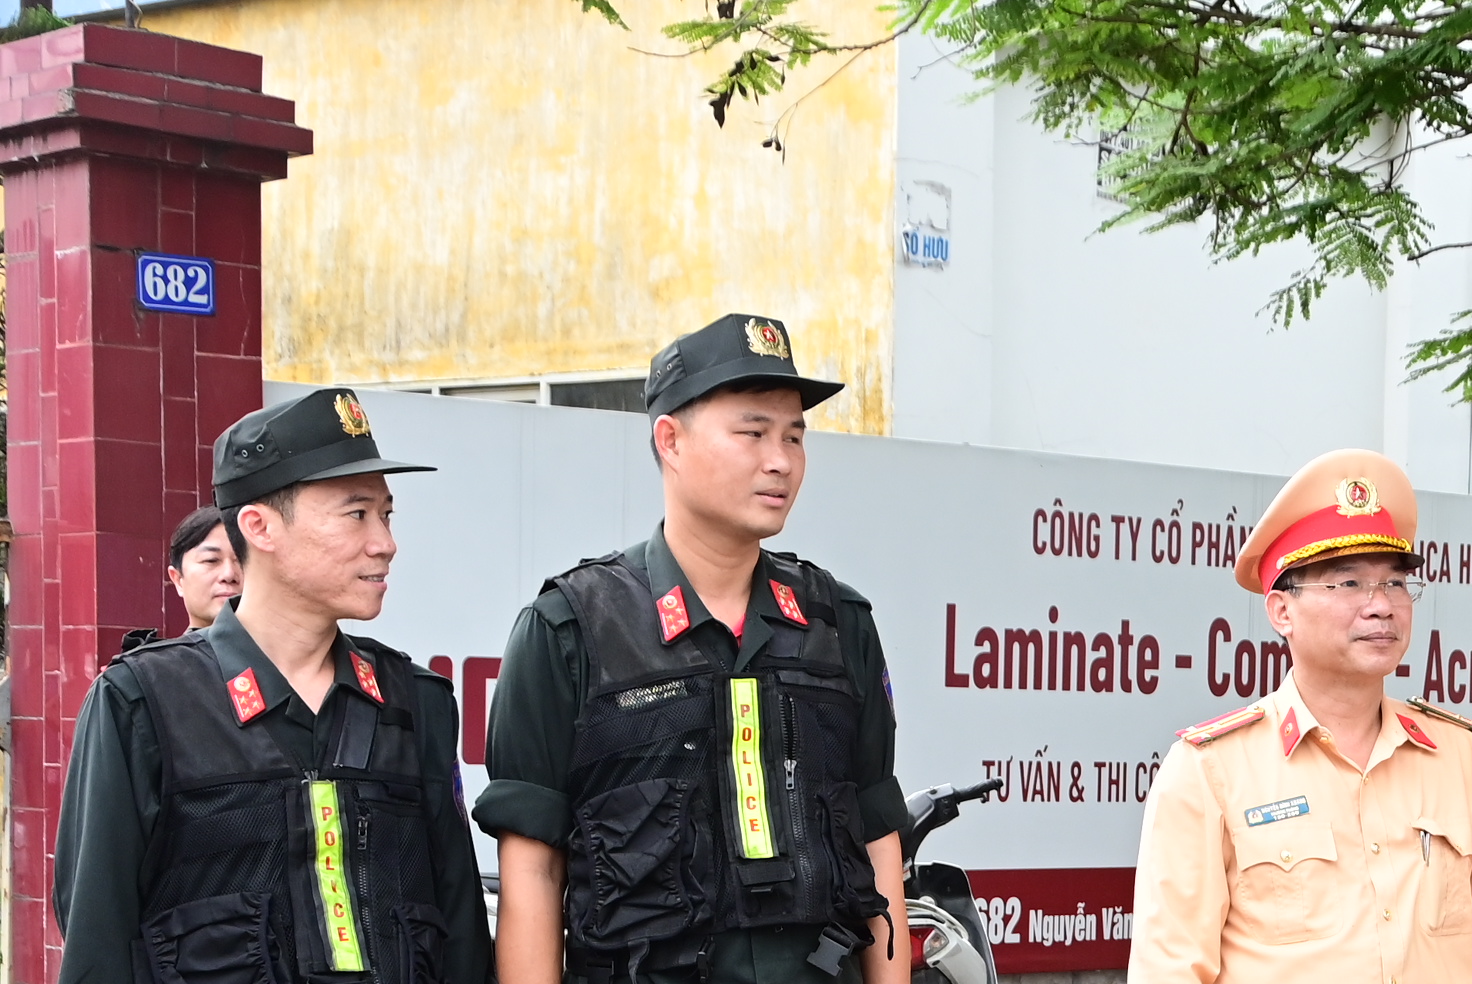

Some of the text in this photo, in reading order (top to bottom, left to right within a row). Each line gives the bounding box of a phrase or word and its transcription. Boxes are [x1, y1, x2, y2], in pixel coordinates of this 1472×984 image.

[144, 262, 208, 304] 682
[1032, 498, 1101, 558] CÔNG
[1111, 514, 1142, 561] TY
[1151, 499, 1183, 564] CỔ
[1405, 540, 1451, 583] ICA
[945, 603, 1160, 694] Laminate
[1175, 654, 1192, 669] -
[1207, 617, 1293, 698] Com
[1395, 664, 1410, 677] -
[740, 704, 760, 832] POLICE
[982, 755, 1013, 802] TƯ
[1019, 745, 1061, 802] VẤN
[1068, 761, 1085, 803] &
[1094, 762, 1127, 802] THI
[321, 806, 349, 942] POLICE
[1028, 902, 1097, 946] Nguyễn
[1101, 906, 1134, 940] Văn
